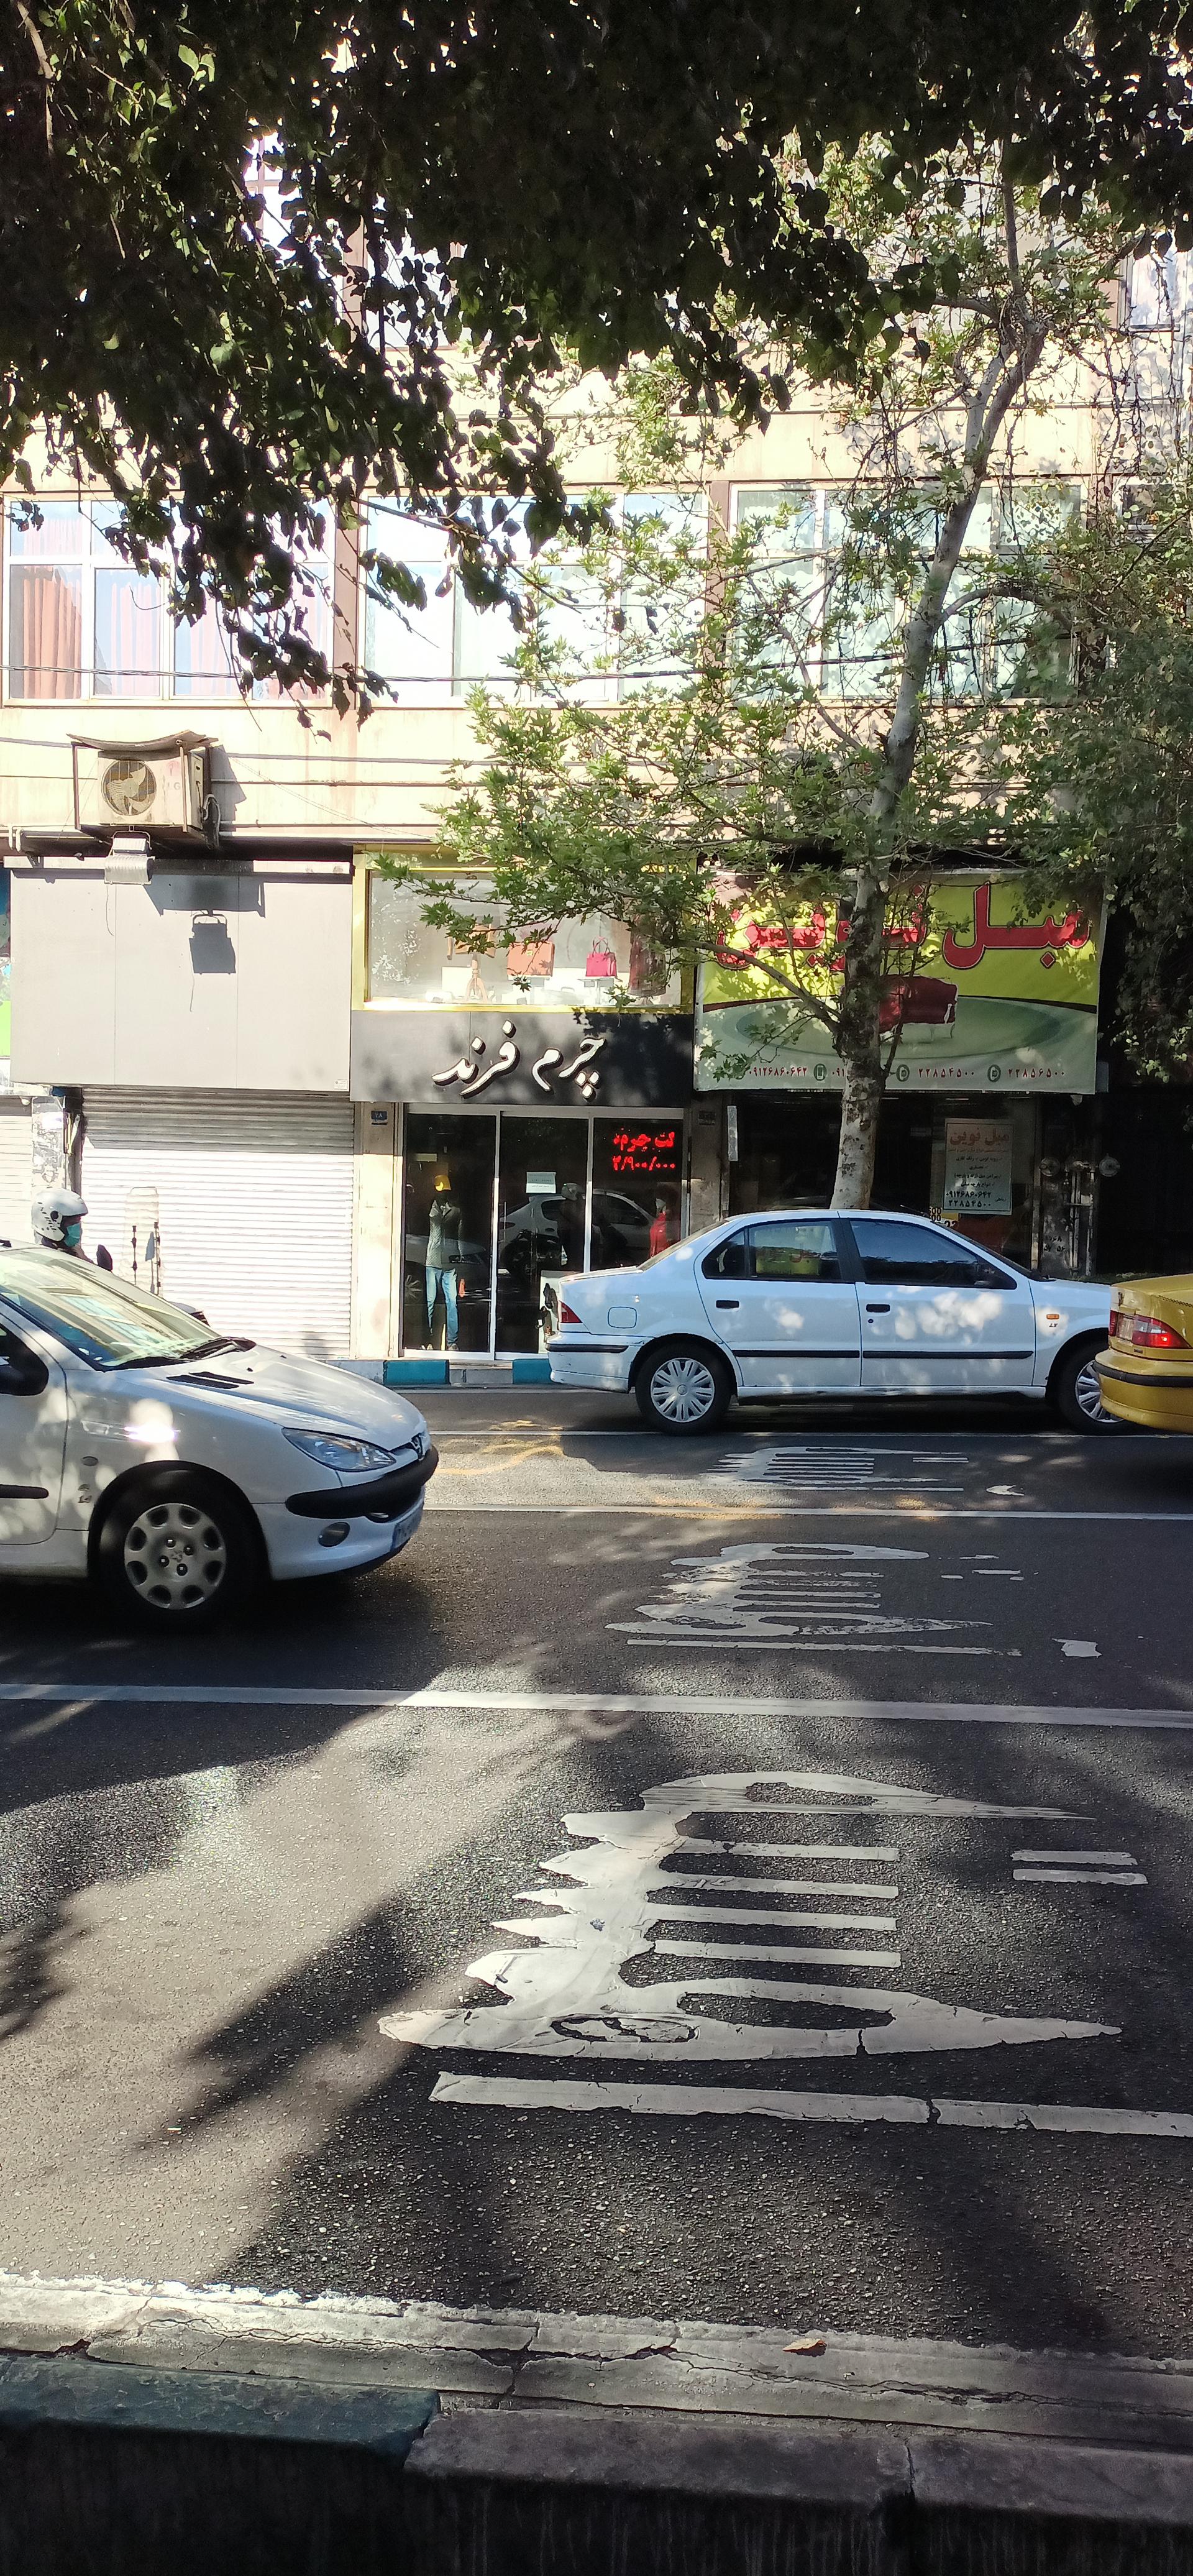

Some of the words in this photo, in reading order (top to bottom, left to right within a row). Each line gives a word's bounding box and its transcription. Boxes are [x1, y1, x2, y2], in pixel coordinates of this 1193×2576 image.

[943, 881, 1090, 971] مبل
[431, 1019, 516, 1096] فرند
[532, 1037, 606, 1099] چرم
[918, 1068, 975, 1078] ۲۲۸۵۴۵۰۰
[1008, 1068, 1065, 1078] ۲۲۸۵۶۵۰۰
[949, 1127, 980, 1146] نوین
[984, 1127, 1010, 1146] مبل
[948, 1199, 991, 1208] ۲۲۸۵۴۵۰۰
